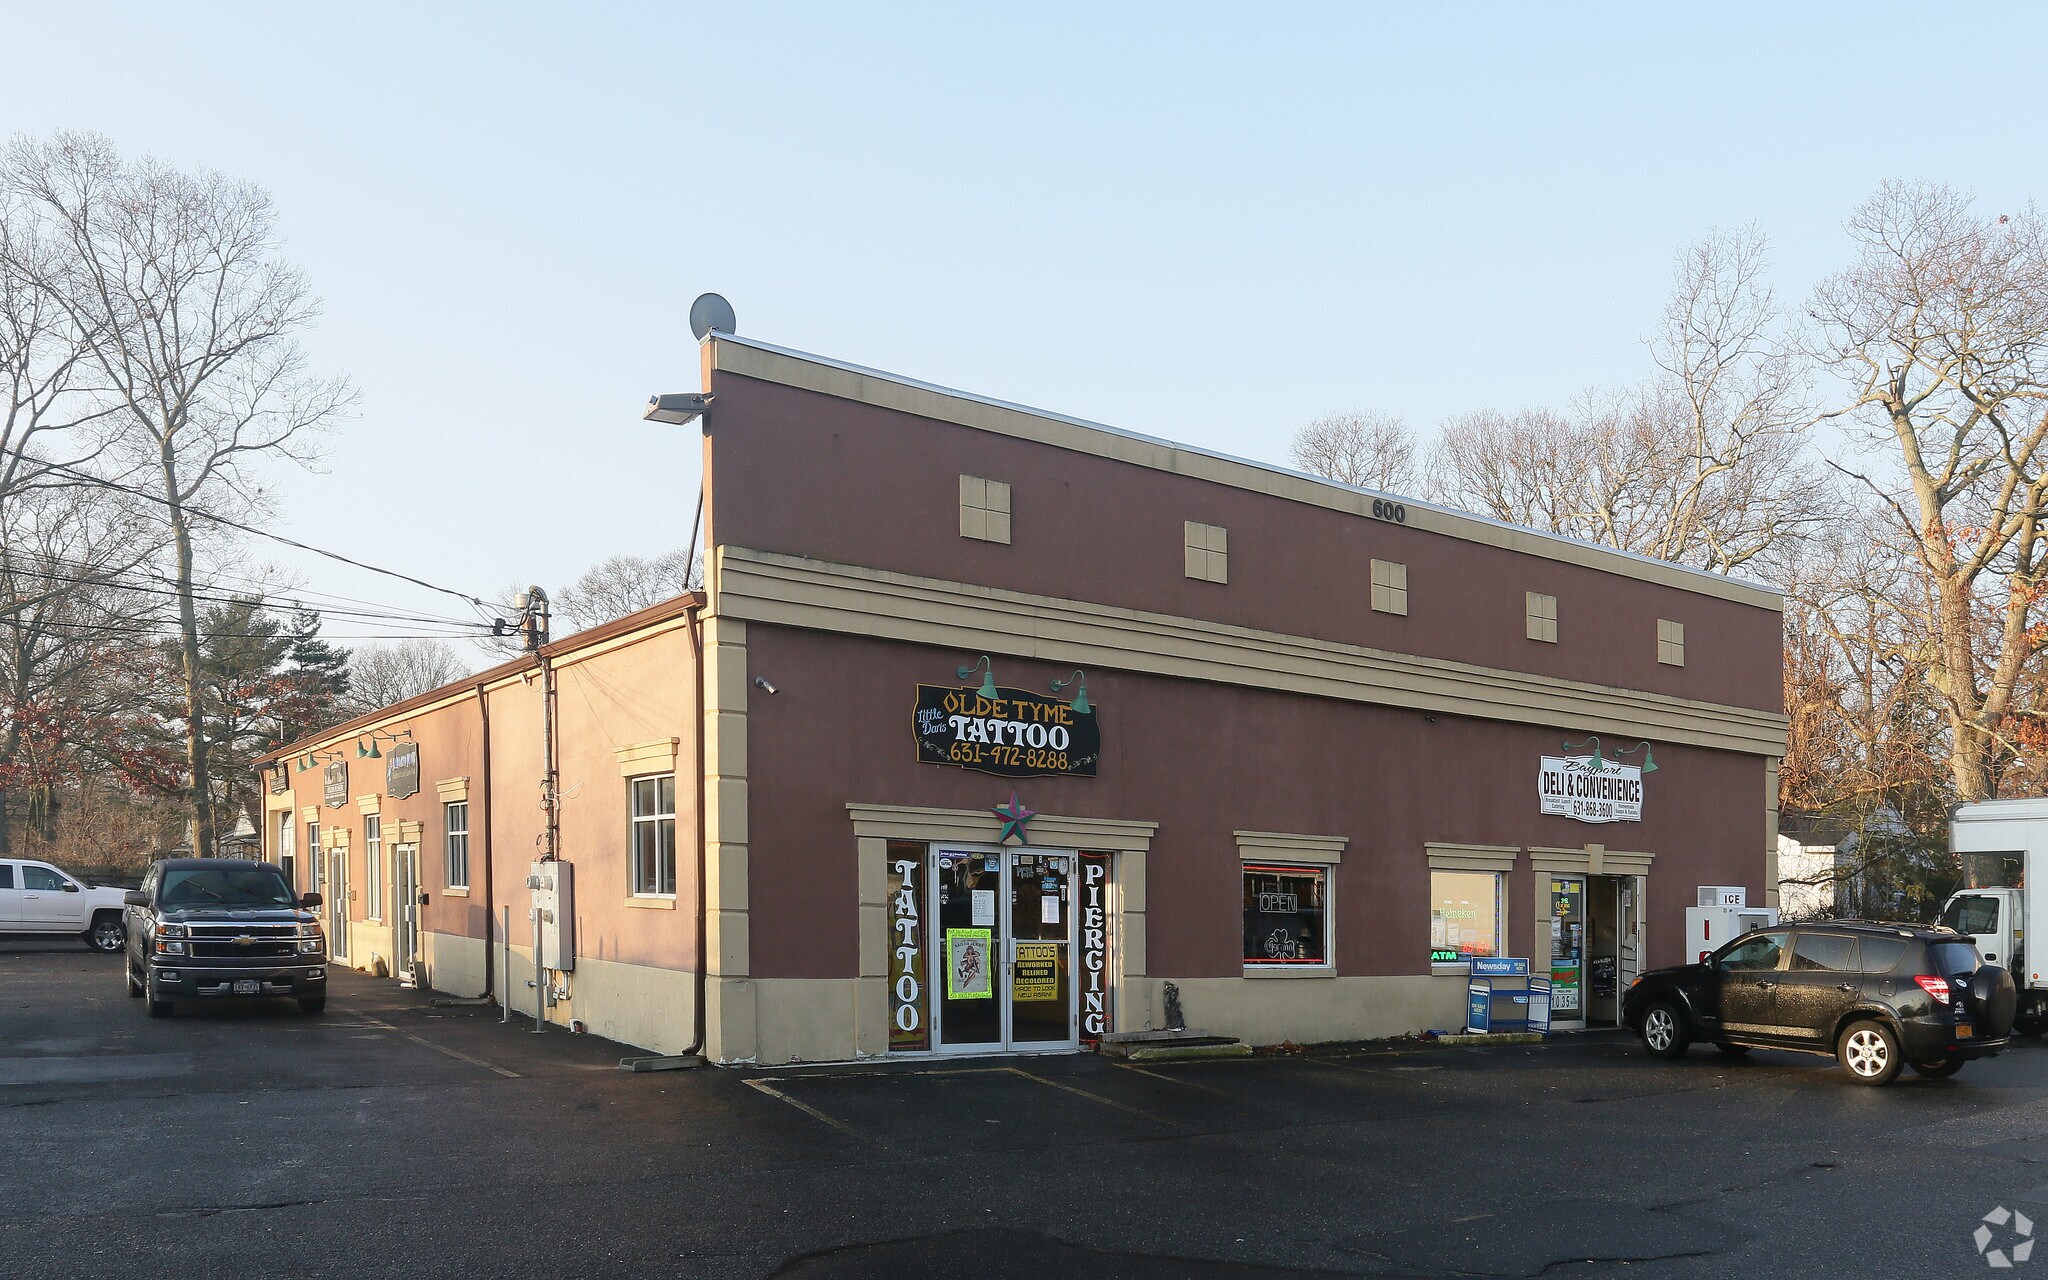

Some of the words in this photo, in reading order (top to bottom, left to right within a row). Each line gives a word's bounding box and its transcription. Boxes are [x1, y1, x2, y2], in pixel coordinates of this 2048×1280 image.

[1373, 499, 1405, 523] 600
[917, 708, 944, 723] Little
[943, 691, 1008, 719] OLDE
[1012, 700, 1073, 725] TYME
[949, 715, 1070, 751] TATTOO
[1562, 760, 1622, 777] Bayport
[1543, 771, 1565, 796] DELI
[1567, 773, 1574, 797] &
[1576, 774, 1640, 802] CONVENIENCE
[1573, 800, 1612, 818] 631-868-3600
[1261, 894, 1296, 911] OPEN
[1724, 895, 1740, 904] ICE
[1439, 907, 1476, 919] Heineken
[895, 859, 919, 1031] TATTOO
[1084, 864, 1105, 1034] PIERCING
[1431, 951, 1457, 960] ATM
[1476, 961, 1511, 972] Newsday
